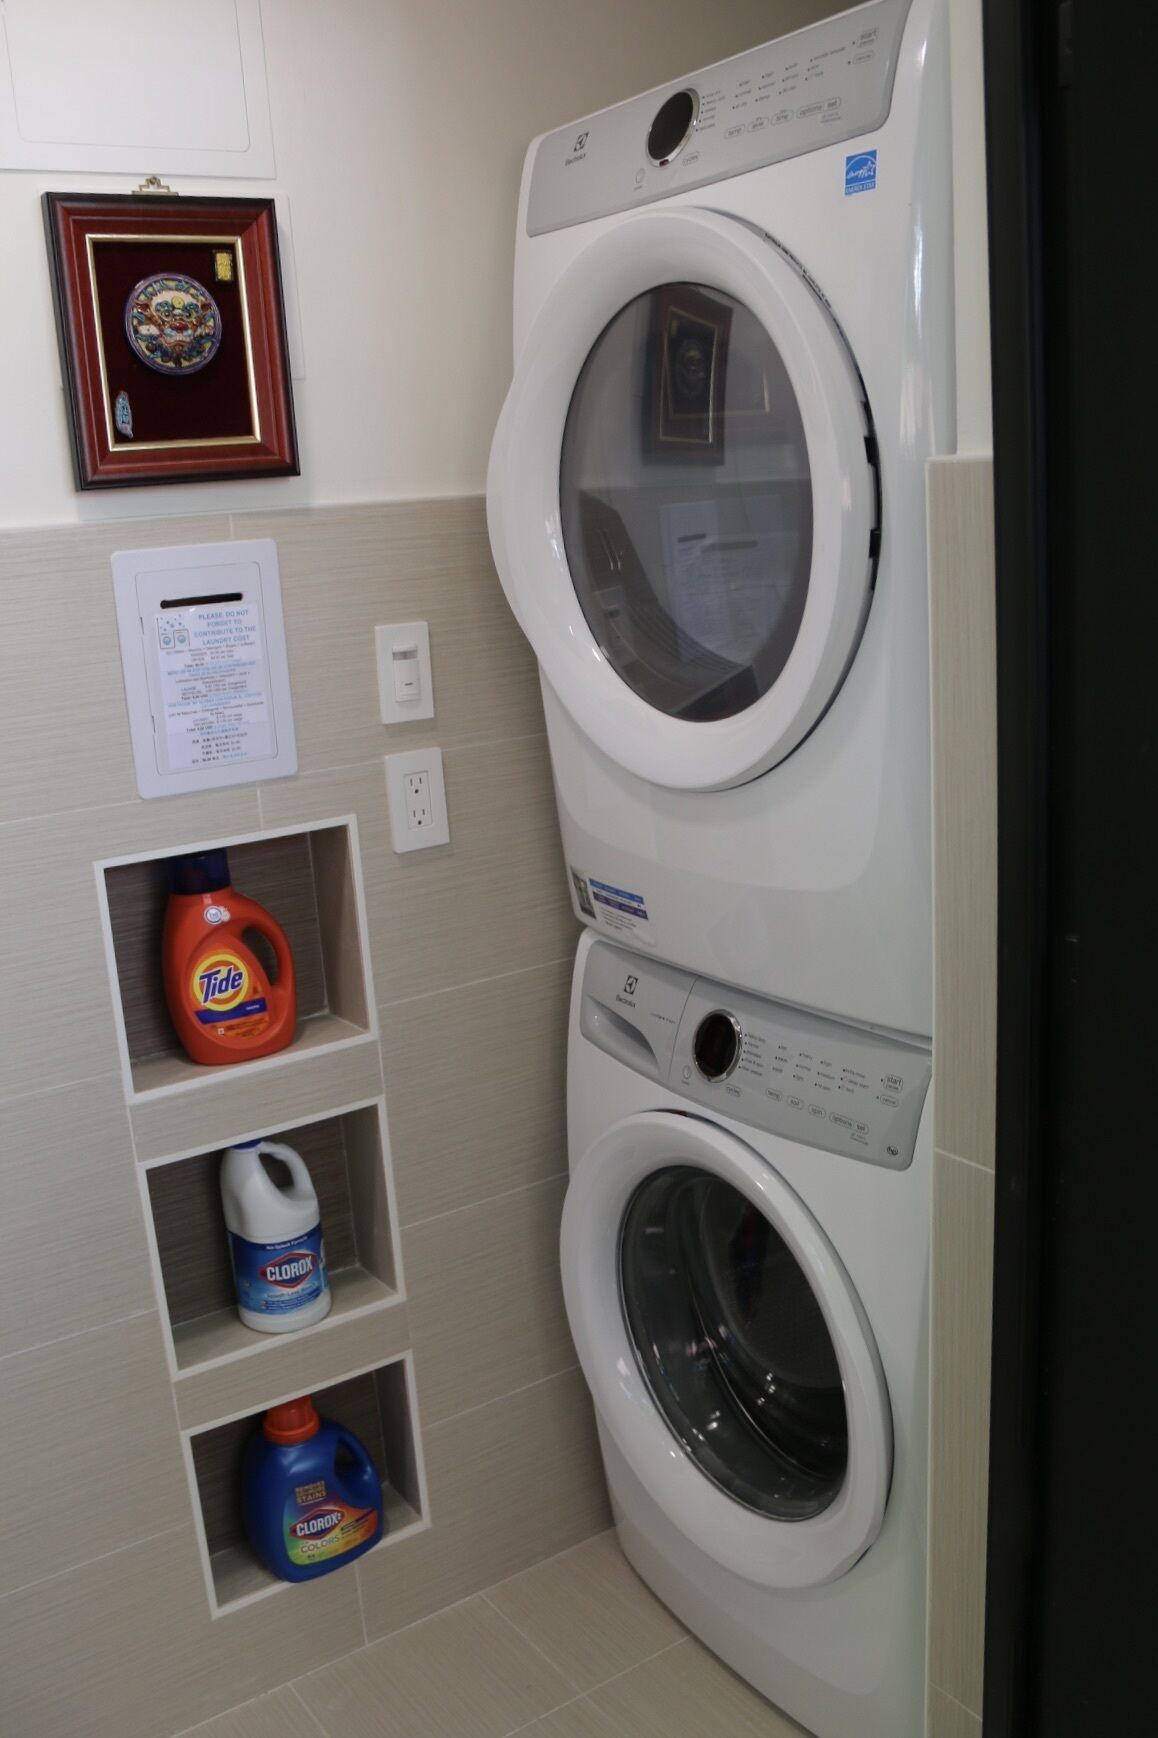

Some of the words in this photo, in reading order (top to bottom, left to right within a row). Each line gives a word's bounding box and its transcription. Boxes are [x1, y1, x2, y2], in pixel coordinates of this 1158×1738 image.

[235, 609, 249, 617] NOT
[207, 620, 232, 628] FORGET
[193, 628, 234, 638] CONTRIBUTE
[244, 625, 257, 633] THE
[202, 637, 232, 646] LAUNDRY
[233, 634, 250, 643] COST
[199, 965, 243, 1005] Tide
[266, 1256, 313, 1281] CLOROX
[300, 1534, 341, 1553] COLORS
